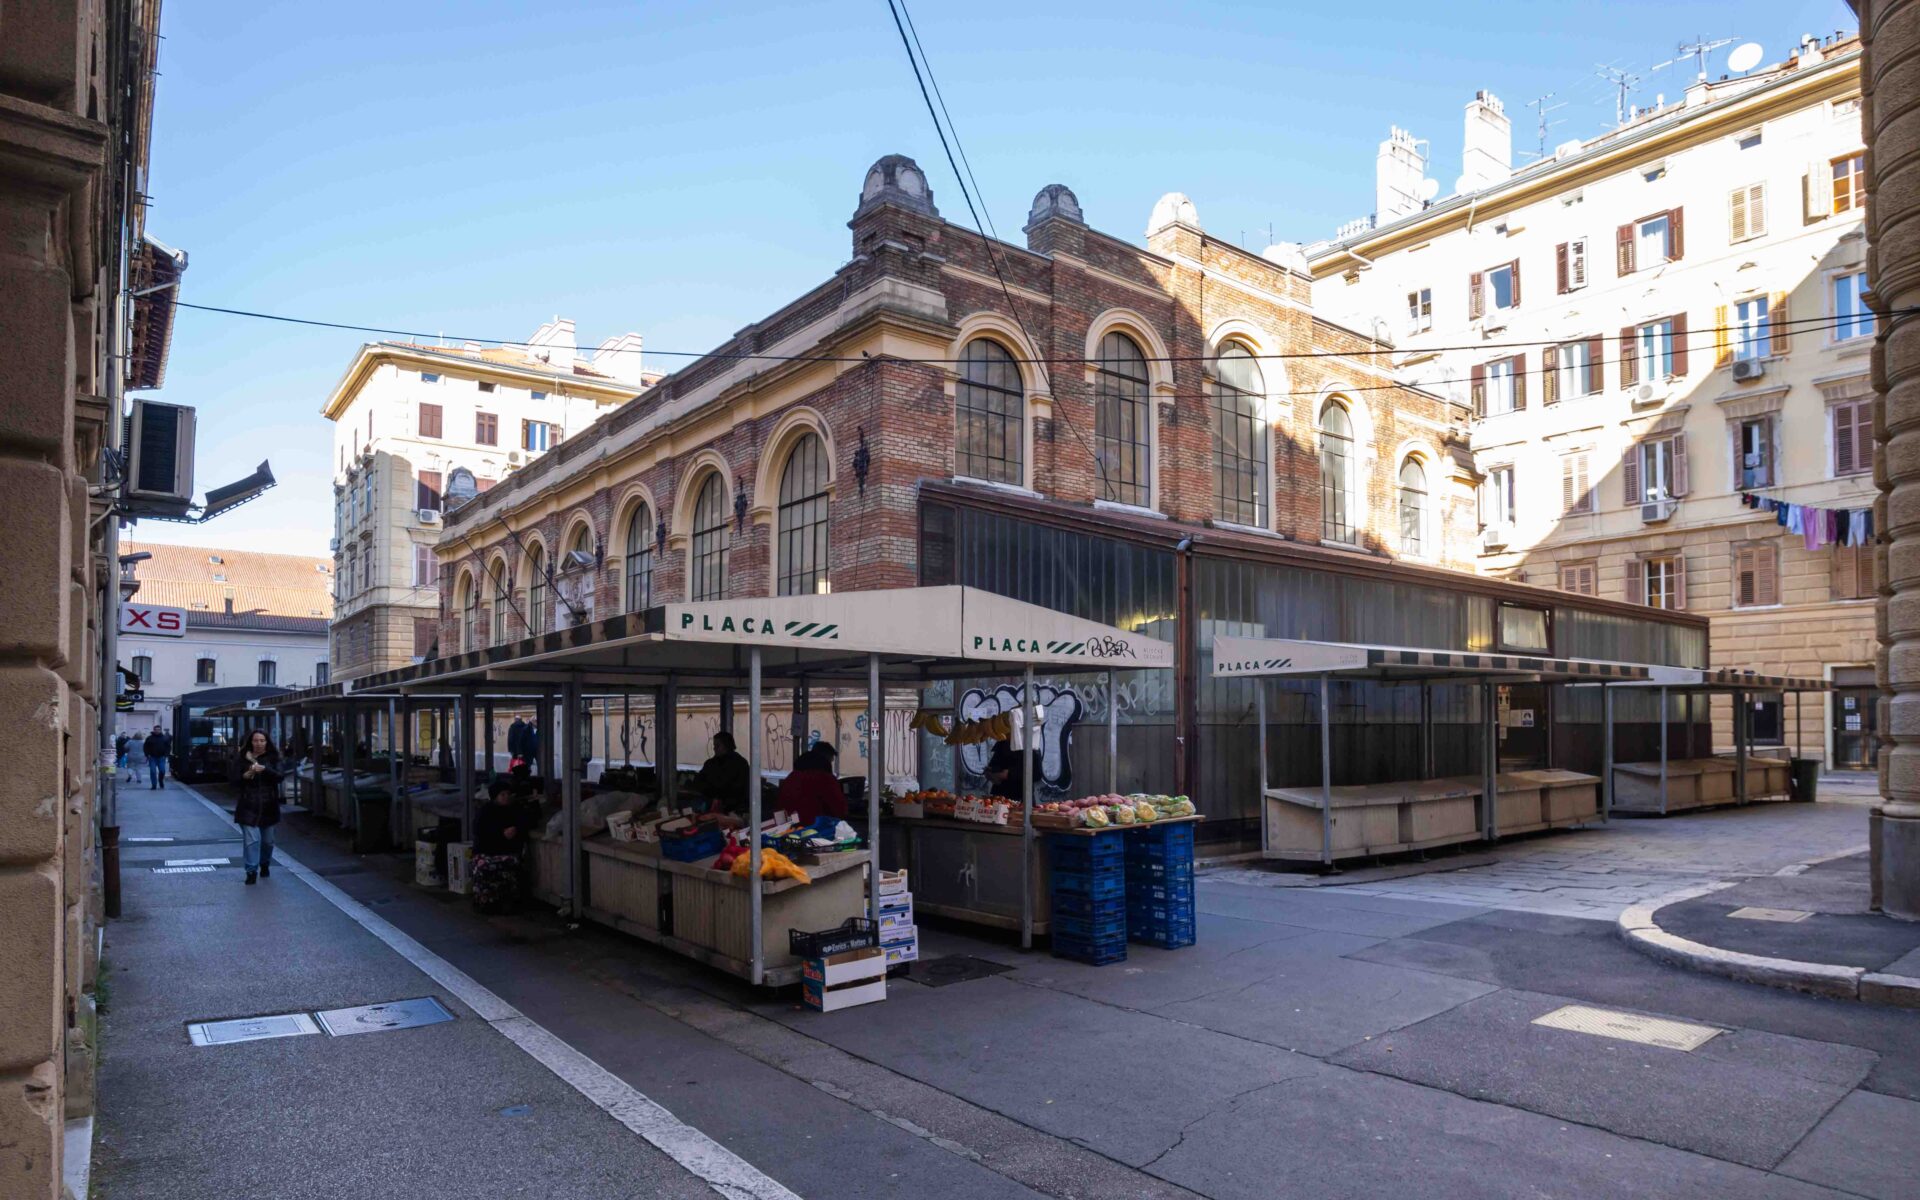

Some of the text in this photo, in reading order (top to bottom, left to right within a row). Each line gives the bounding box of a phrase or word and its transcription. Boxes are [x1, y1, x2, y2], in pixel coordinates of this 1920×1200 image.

[127, 608, 181, 630] XS
[681, 613, 775, 635] PLACA
[974, 636, 1040, 653] PLACA
[1219, 661, 1260, 672] PLACA
